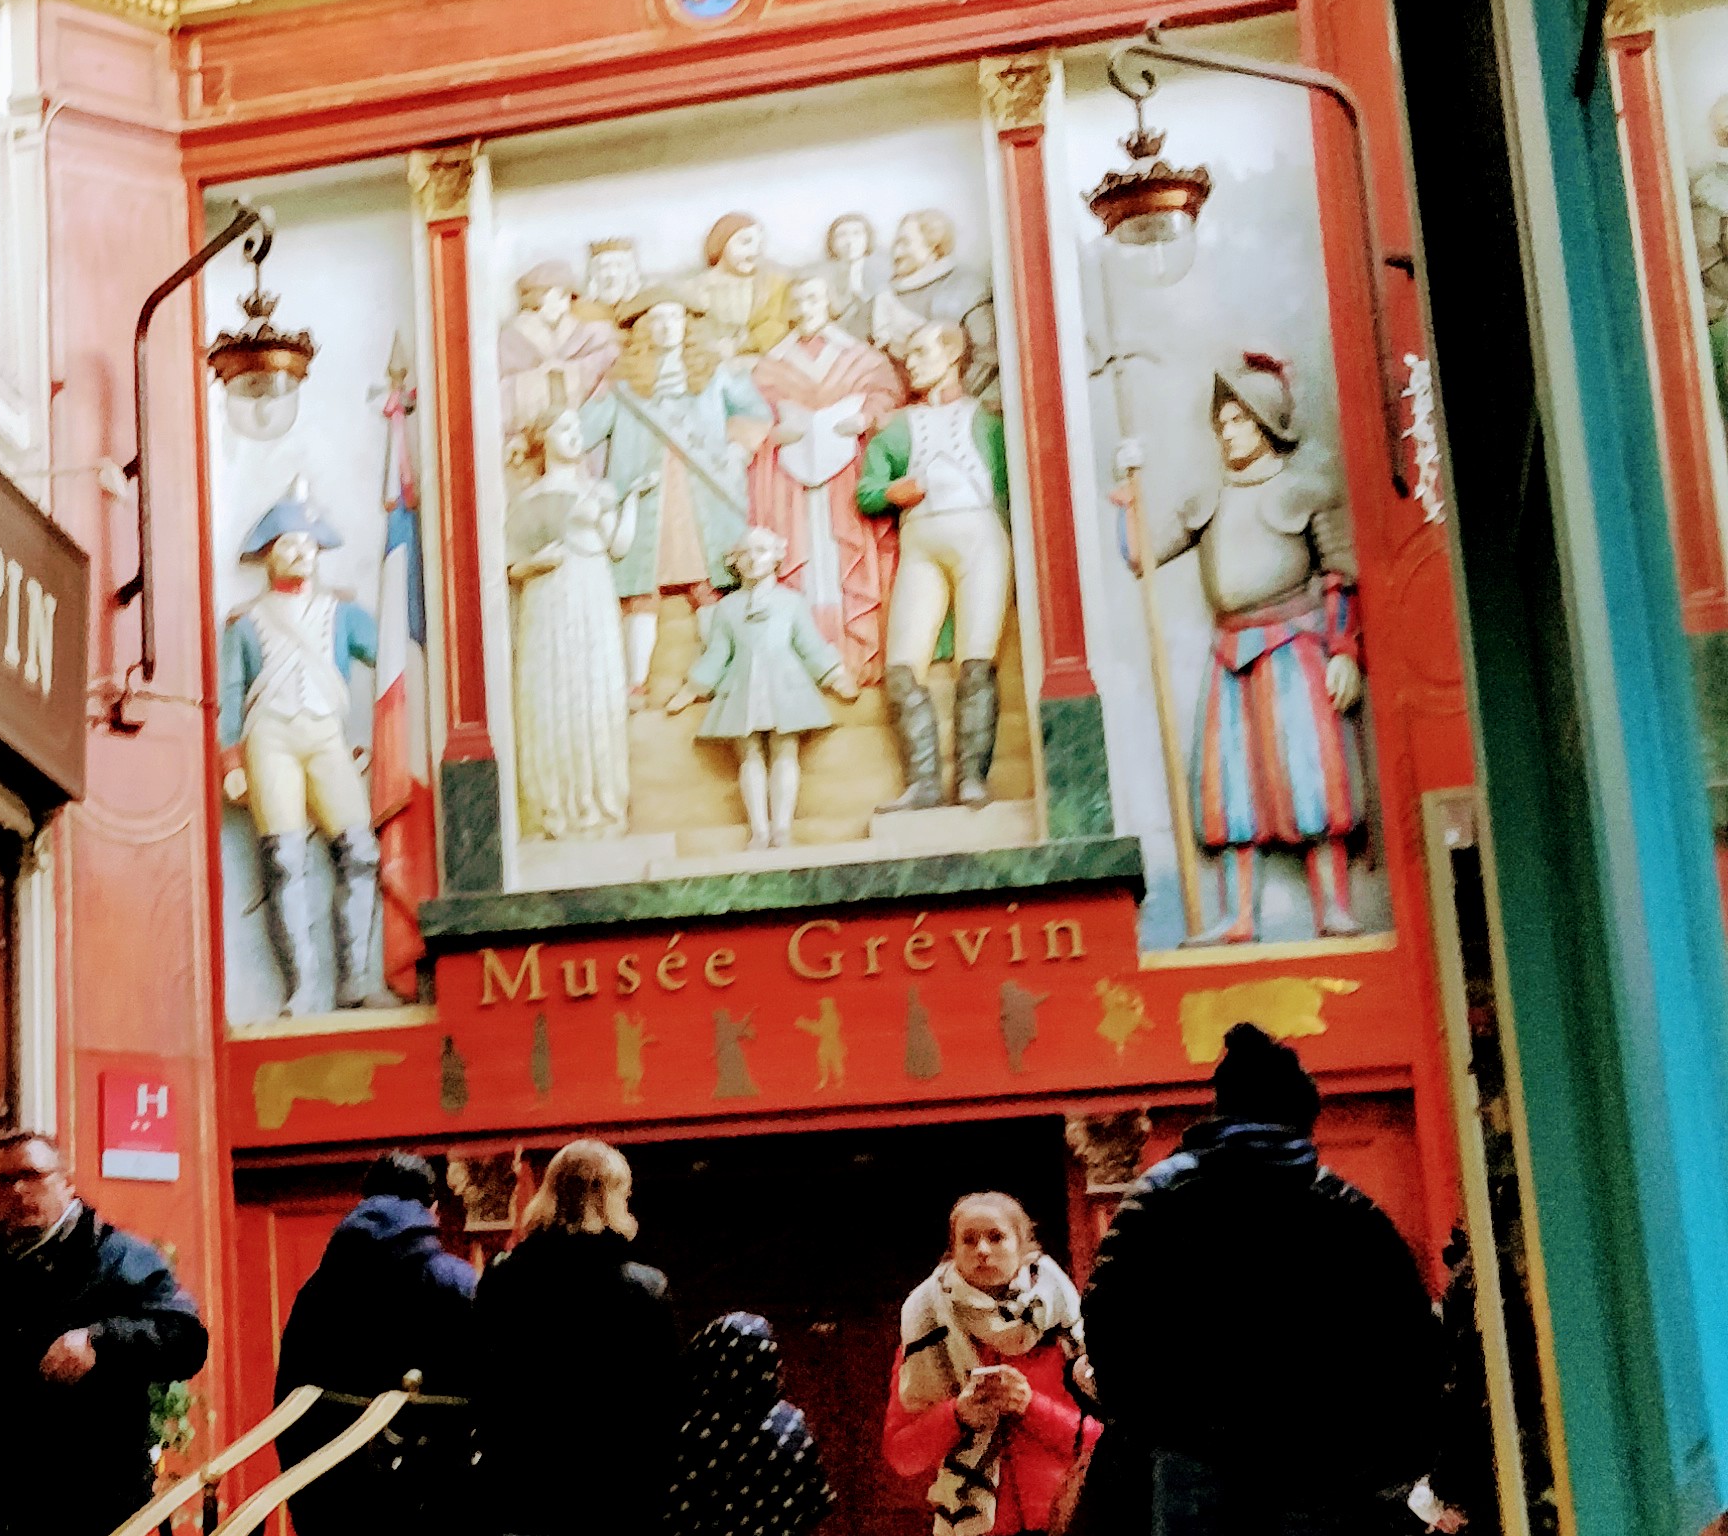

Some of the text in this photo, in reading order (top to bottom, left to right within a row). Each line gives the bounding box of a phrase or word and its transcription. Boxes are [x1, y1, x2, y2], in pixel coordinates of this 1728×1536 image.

[478, 902, 1086, 1006] Musée Grévin
[136, 1083, 168, 1119] H
